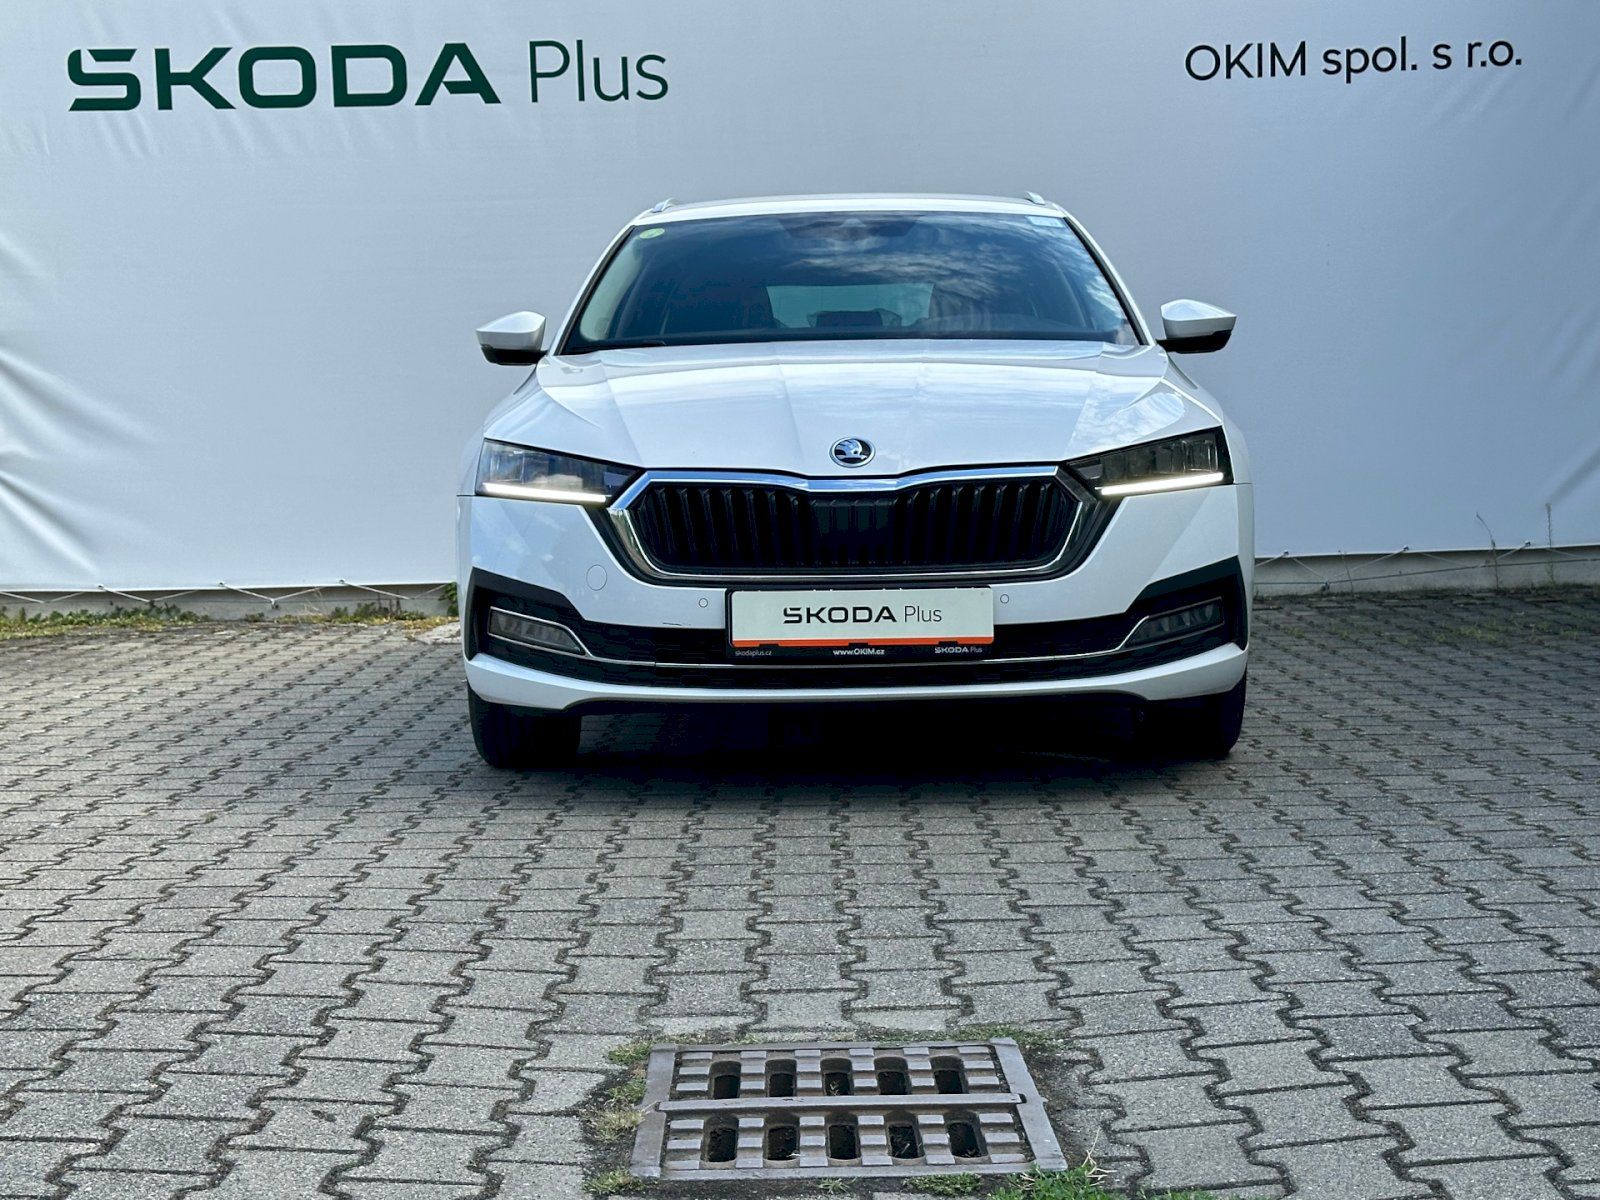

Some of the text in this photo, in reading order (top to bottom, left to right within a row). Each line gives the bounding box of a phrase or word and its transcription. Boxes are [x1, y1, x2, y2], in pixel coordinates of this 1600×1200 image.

[1185, 35, 1522, 84] OKIM spol. s r.o.
[529, 39, 669, 103] Plus
[904, 605, 942, 622] Plus
[735, 649, 773, 657] skodaplus.cz
[832, 647, 885, 656] www.OKIM.cz
